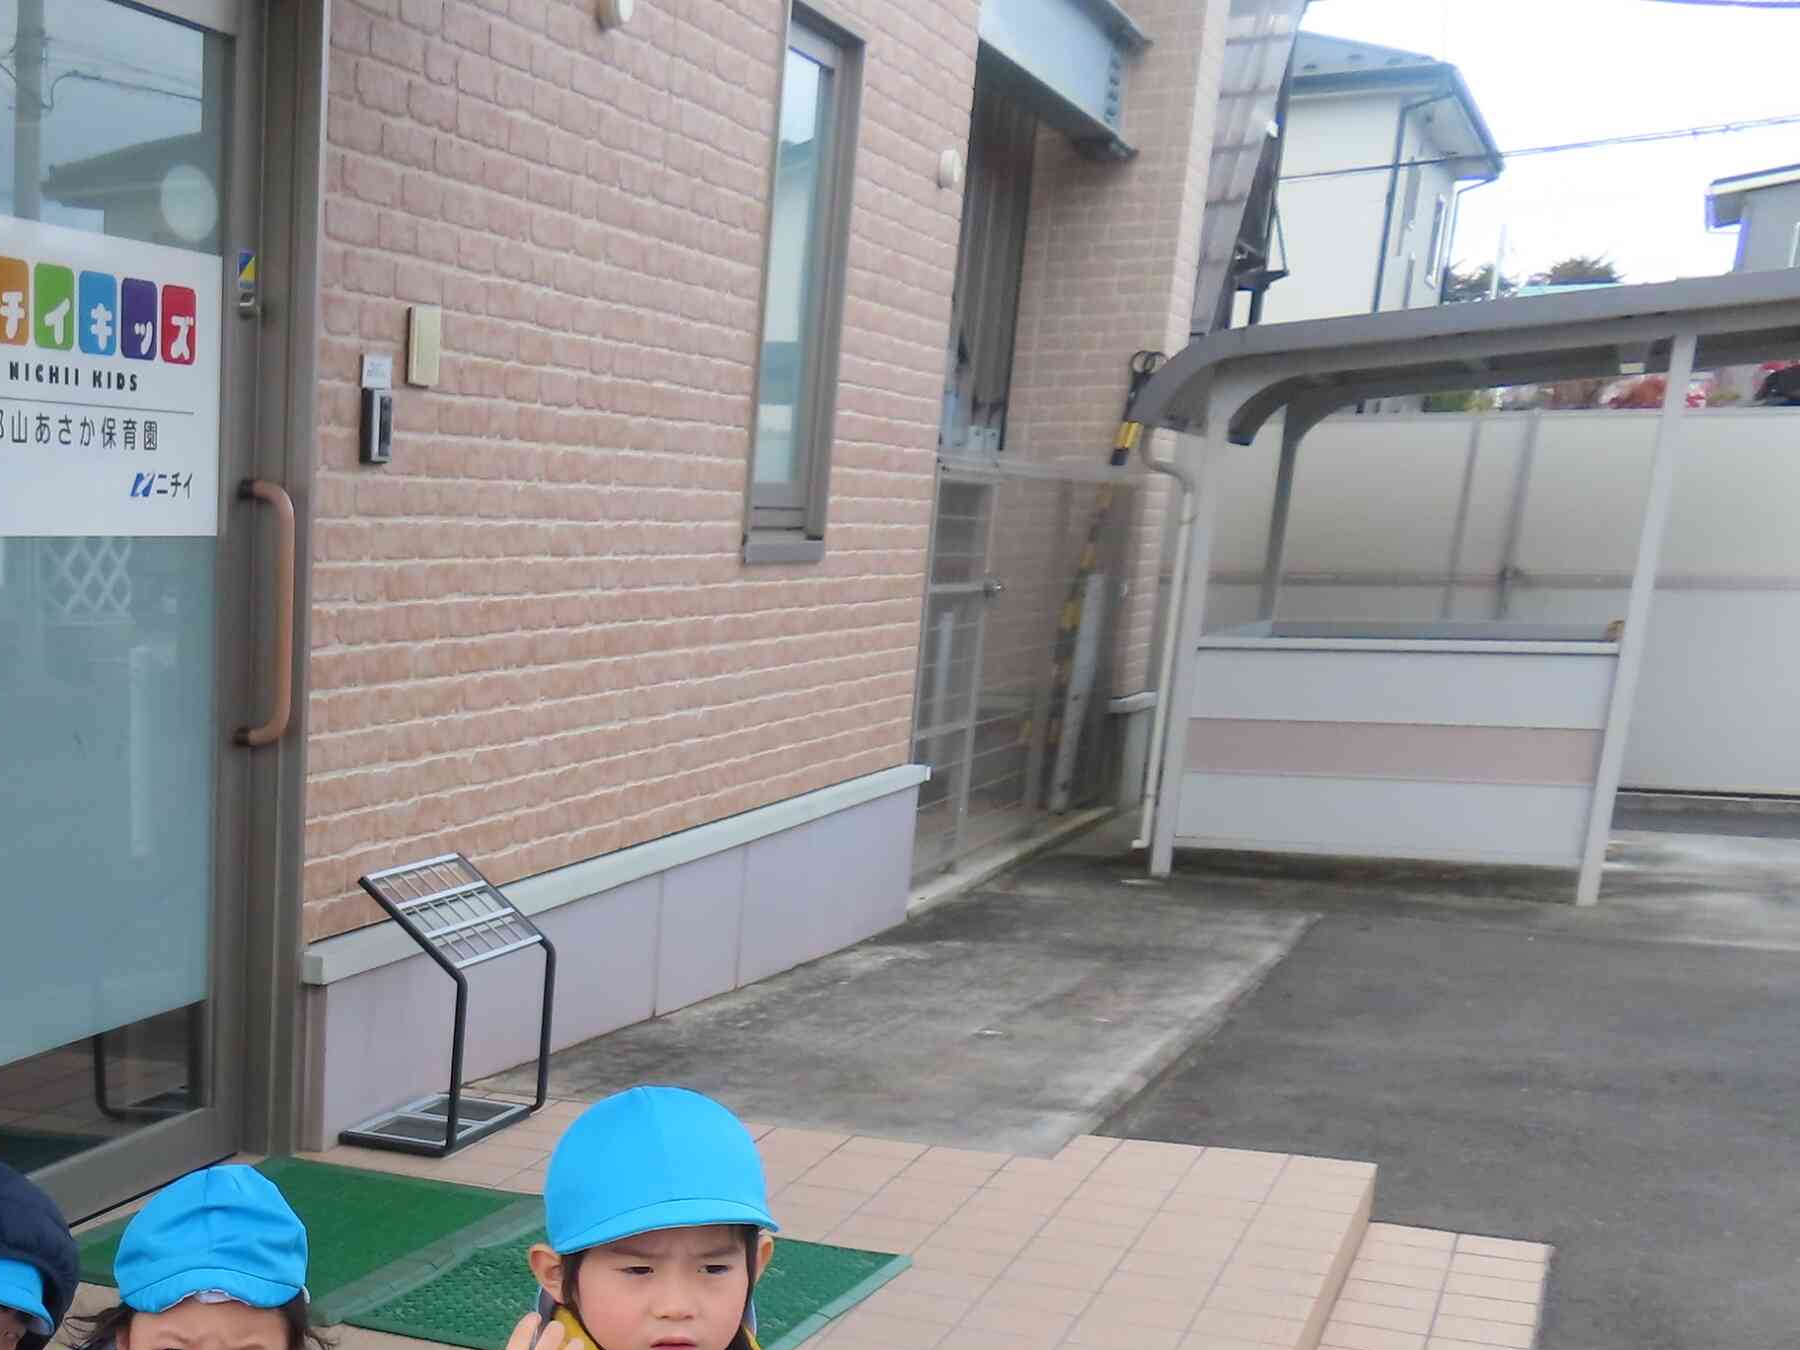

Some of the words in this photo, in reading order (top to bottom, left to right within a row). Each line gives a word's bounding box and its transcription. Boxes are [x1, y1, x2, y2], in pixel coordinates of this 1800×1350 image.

[8, 360, 80, 387] NICHII
[91, 369, 138, 392] KIDS
[155, 471, 194, 500] ニチイ
